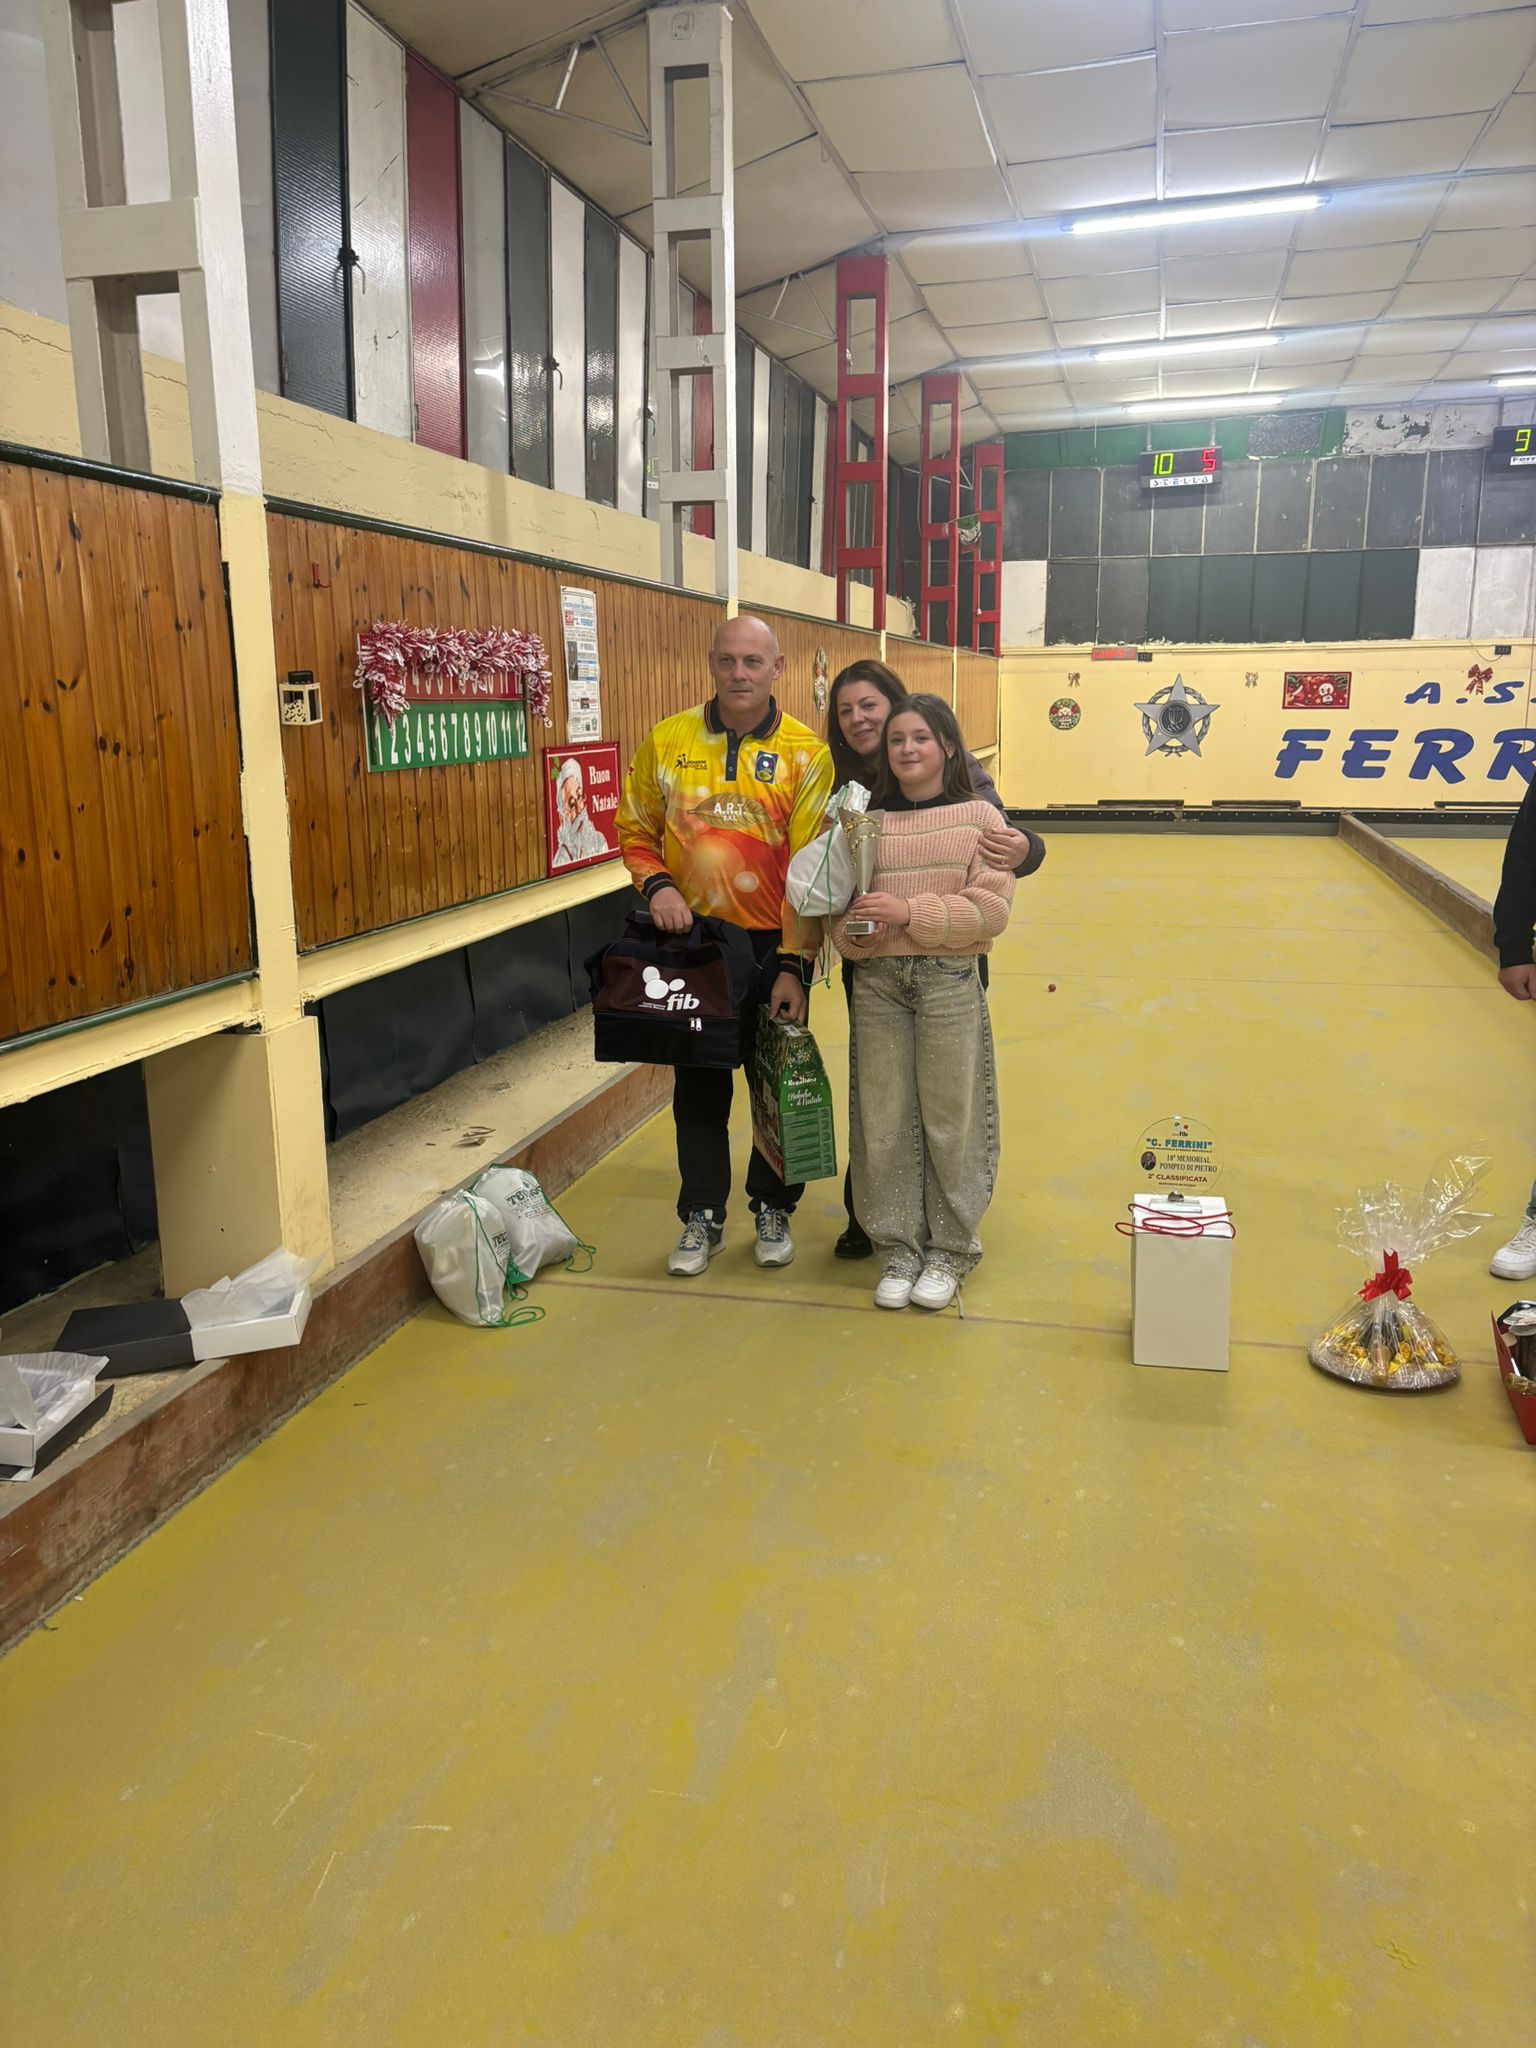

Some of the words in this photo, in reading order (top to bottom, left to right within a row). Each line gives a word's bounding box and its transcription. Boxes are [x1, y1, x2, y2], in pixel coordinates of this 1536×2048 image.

[1514, 429, 1531, 452] 9
[1153, 453, 1174, 475] 10
[1202, 448, 1216, 472] 5
[402, 714, 412, 764] 3
[416, 713, 424, 762] 4
[428, 713, 436, 761] 5
[440, 713, 448, 760] 6
[450, 713, 458, 758] 7
[463, 712, 471, 758] 8
[474, 712, 482, 757] 9
[486, 711, 497, 755] 10
[500, 711, 512, 754] 11
[516, 710, 527, 752] 12
[588, 765, 611, 785] Buon
[592, 792, 618, 813] Natale
[666, 994, 700, 1011] fib
[1159, 1162, 1186, 1171] POMPEO
[1194, 1164, 1218, 1173] PIETRO
[1177, 1154, 1211, 1164] MEMORIAL
[1156, 1174, 1207, 1182] CLASSIFICATA
